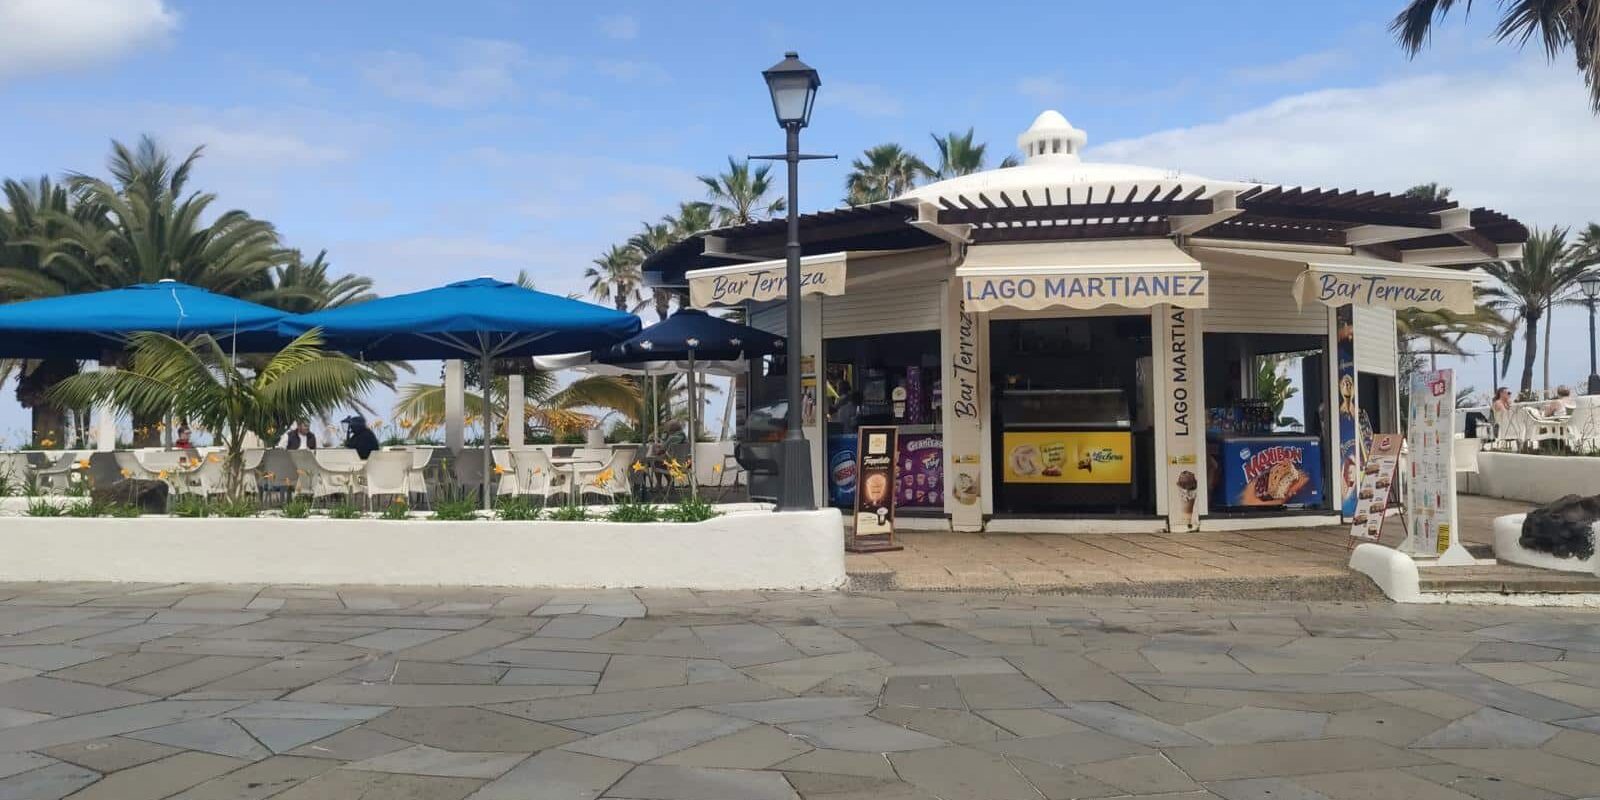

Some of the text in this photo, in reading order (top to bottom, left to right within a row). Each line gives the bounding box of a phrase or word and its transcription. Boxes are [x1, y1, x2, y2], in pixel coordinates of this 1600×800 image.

[712, 271, 825, 300] Bar Terrza
[967, 276, 1204, 301] LAGO MARTIANEZ
[1319, 275, 1444, 304] Bar Terraza
[954, 378, 978, 418] Bar
[1174, 389, 1189, 436] LAGO
